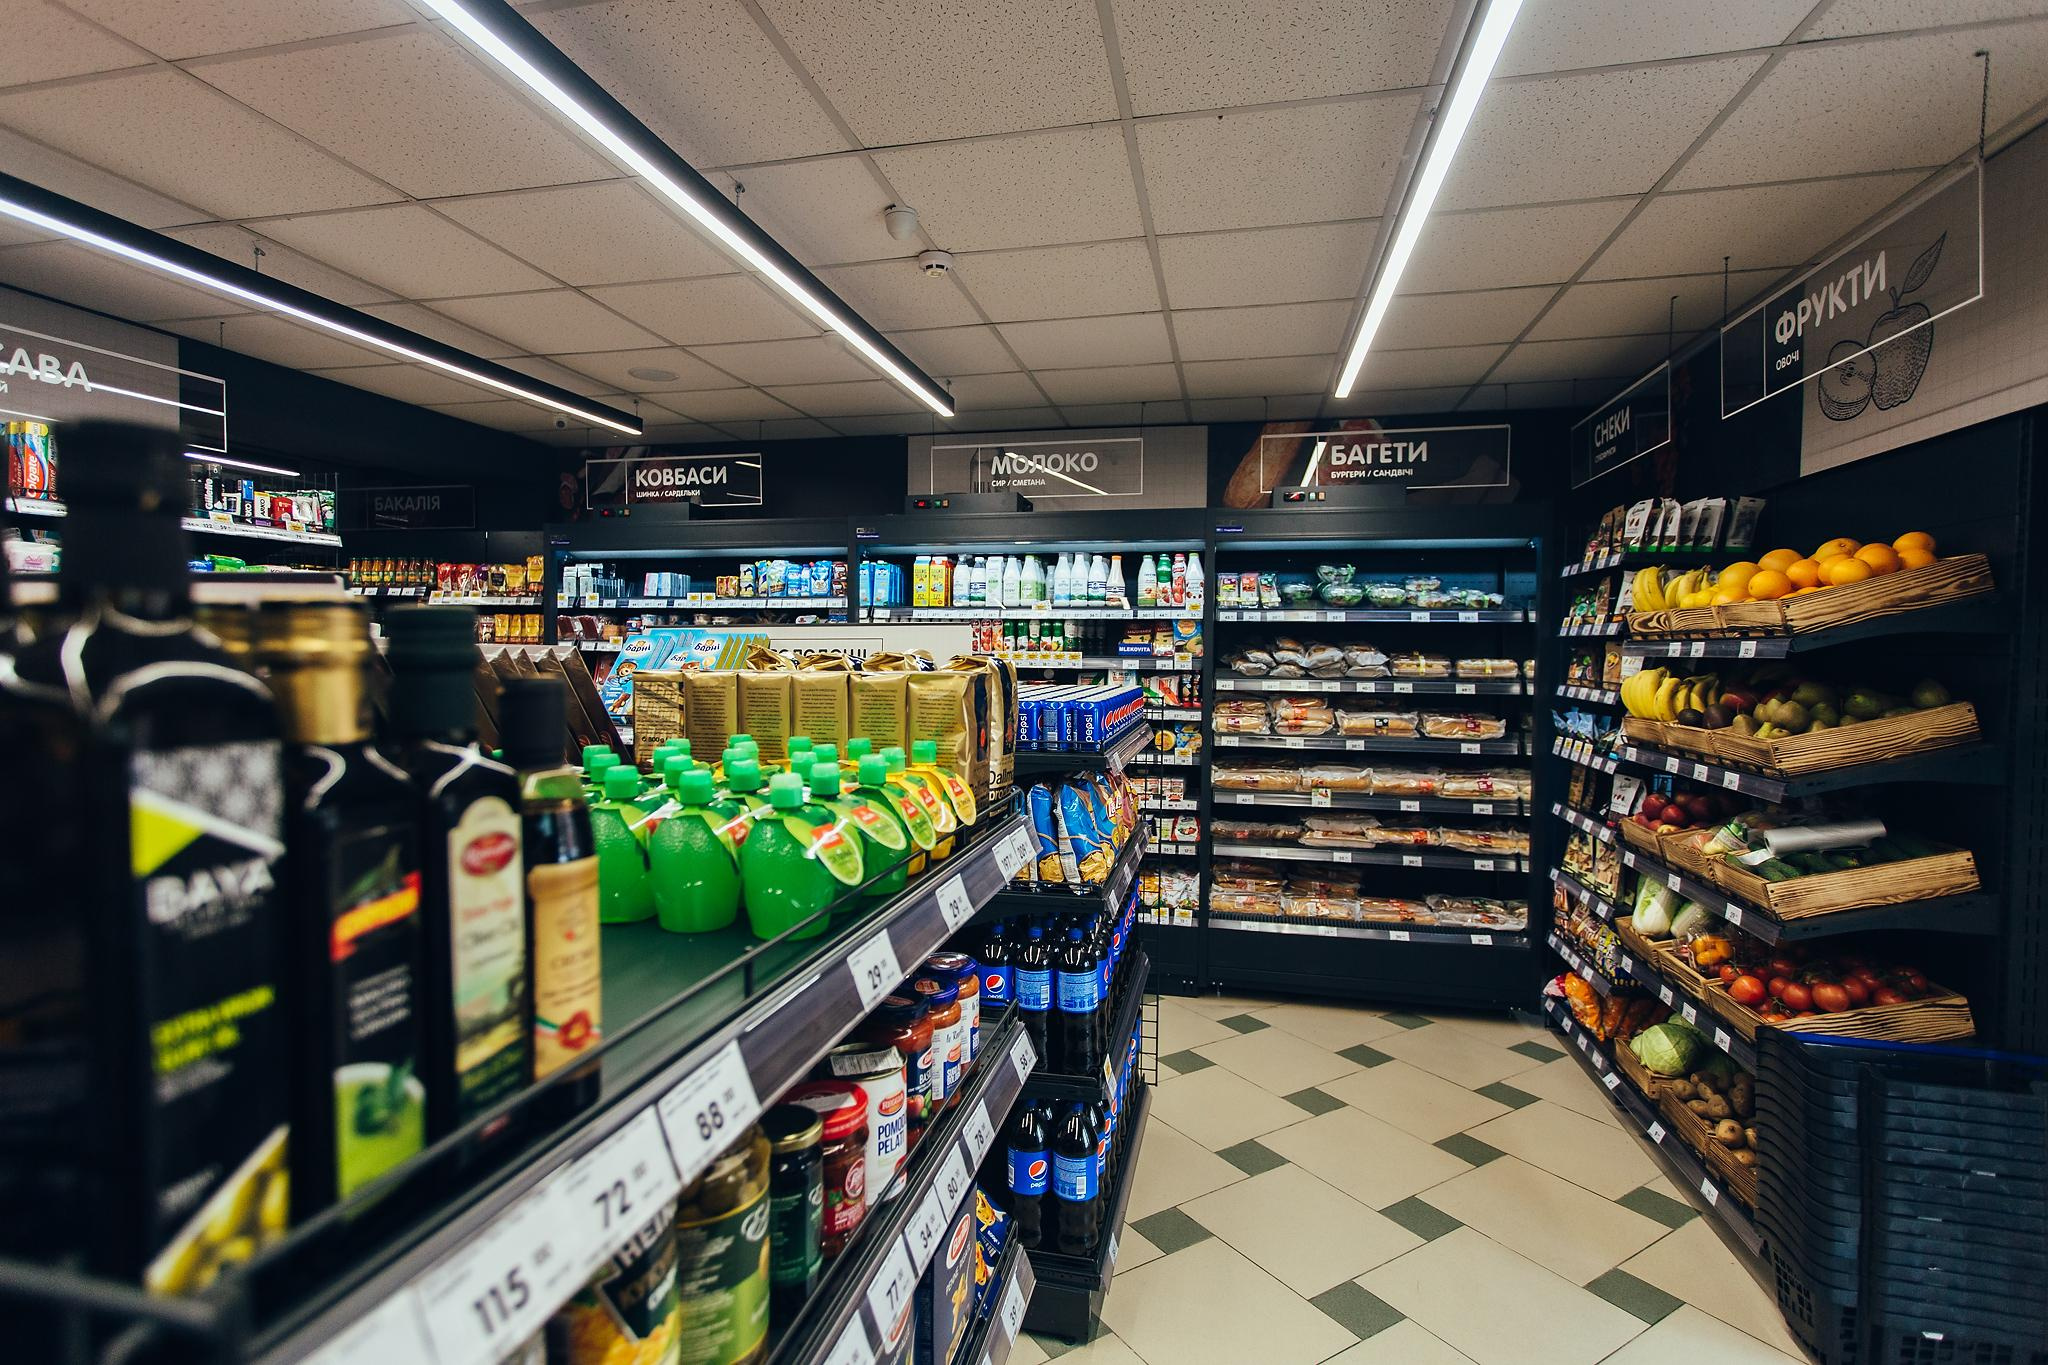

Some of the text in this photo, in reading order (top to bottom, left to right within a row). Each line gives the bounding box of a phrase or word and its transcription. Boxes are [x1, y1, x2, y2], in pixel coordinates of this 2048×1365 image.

[1775, 250, 1887, 345] ФРУКТИ
[1775, 350, 1800, 371] ОВОЧІ
[1594, 405, 1630, 447] СНЕКИ
[991, 452, 1098, 476] МОЛОКО
[1331, 441, 1428, 465] БАГЕТИ
[636, 466, 727, 487] КОВБАСИ
[1012, 478, 1046, 486] СМЕТАНА
[1331, 470, 1366, 479] БУРГЕРИ
[1373, 468, 1413, 478] САНДВІЧІ
[375, 496, 440, 512] БАКАЛІЯ
[664, 489, 700, 497] САРДЕЛЬКИ
[1119, 645, 1151, 653] MLEKOVITA
[1019, 713, 1029, 741] pepsi
[1084, 714, 1094, 743] pepsi
[989, 768, 1015, 785] Dallm
[949, 900, 960, 919] 29
[868, 965, 882, 990] 29
[920, 1069, 932, 1084] BAS
[696, 1101, 724, 1141] 88
[974, 1129, 985, 1151] 78
[947, 1176, 959, 1200] 80
[594, 1179, 632, 1230] 72
[920, 1223, 932, 1249] 34
[474, 1264, 530, 1335] 115
[886, 1279, 899, 1310] 77
